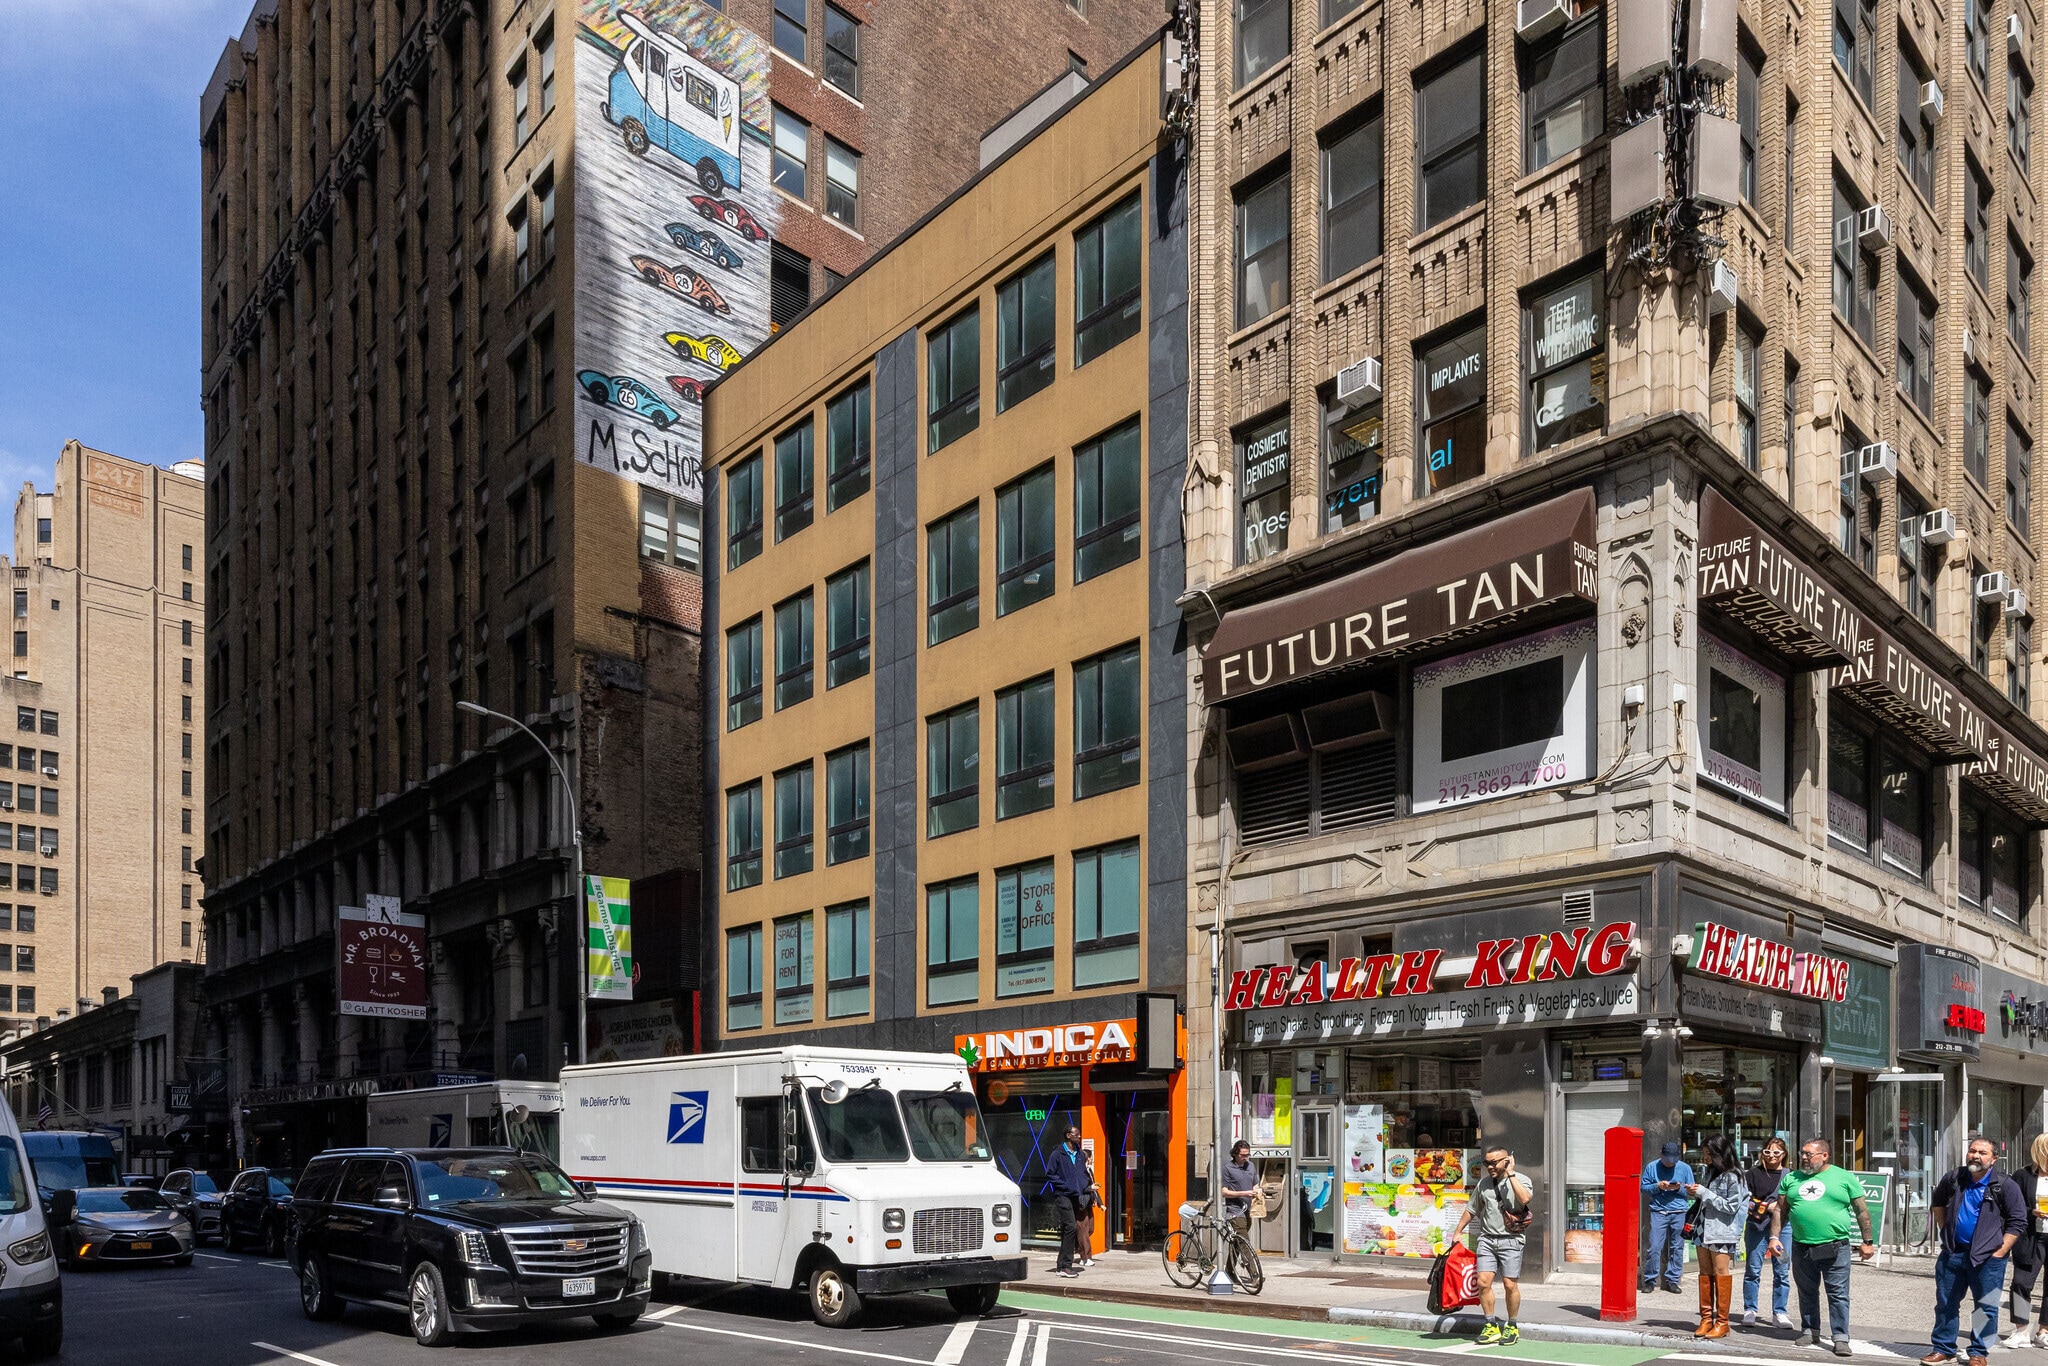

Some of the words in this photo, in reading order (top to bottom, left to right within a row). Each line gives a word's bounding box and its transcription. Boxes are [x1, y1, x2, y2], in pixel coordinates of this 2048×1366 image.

[675, 275, 690, 290] 28
[1431, 352, 1481, 392] IMPLANTS
[619, 389, 635, 406] 26
[1247, 428, 1288, 461] COSMETIC
[1430, 438, 1452, 472] al
[94, 462, 136, 489] 247
[1246, 450, 1290, 485] DENTISTRY
[1574, 541, 1597, 566] FUTURE
[1699, 536, 1752, 564] FUTURE
[1575, 560, 1597, 598] TAN
[1699, 555, 1750, 596] TAN
[1758, 539, 1825, 632] FUTURE
[1831, 598, 1860, 658] TAN
[1220, 598, 1410, 696] FUTURE
[1437, 553, 1544, 626] TAN
[1715, 600, 1798, 654] 212-869-4700
[1886, 645, 1953, 729] FUTURE
[1958, 702, 1985, 754] TAN
[1438, 763, 1567, 805] 212-869-4700
[1439, 753, 1565, 788] FUTURETANMIDTOWN.COM
[1708, 760, 1762, 798] 212-869-4700
[2006, 743, 2048, 804] FUTURE
[1023, 882, 1054, 900] STORE
[1034, 900, 1044, 913] &
[594, 884, 622, 972] #GarmentDistrict
[777, 927, 798, 942] SPACE
[1022, 912, 1054, 930] OFFICE
[344, 943, 361, 964] MR.
[359, 926, 424, 971] BROADWAY
[781, 947, 795, 960] FOR
[1697, 921, 1794, 992] HEALTH
[1800, 952, 1849, 1003] KING
[779, 965, 797, 979] RENT
[1223, 949, 1443, 1011] HEALTH
[1464, 920, 1636, 989] KING
[369, 988, 386, 998] Since
[354, 1004, 385, 1014] GLATT
[387, 1007, 426, 1017] KOSHER
[647, 1014, 673, 1028] CHICKEN
[1247, 1017, 1278, 1037] Protein
[1279, 1010, 1311, 1034] Shake,
[1314, 1008, 1367, 1031] Smoothies,
[1370, 1003, 1405, 1026] Frozen
[1407, 1000, 1443, 1029] Yogurt,
[1450, 999, 1480, 1019] Fresh
[1483, 996, 1514, 1017] Fruits
[1517, 993, 1526, 1012] &
[1530, 987, 1596, 1016] Vegetables
[1600, 984, 1632, 1007] Juice
[1834, 1005, 1877, 1038] SATIVA
[985, 1022, 1131, 1058] INDICA
[840, 1064, 875, 1074] 7533945
[989, 1055, 1049, 1069] CANNABIS
[1054, 1049, 1131, 1064] COLLECTIVE
[580, 1097, 588, 1107] We
[589, 1096, 608, 1107] Deliver
[609, 1095, 618, 1106] For
[619, 1095, 631, 1106] You.
[1025, 1110, 1046, 1121] OPEN
